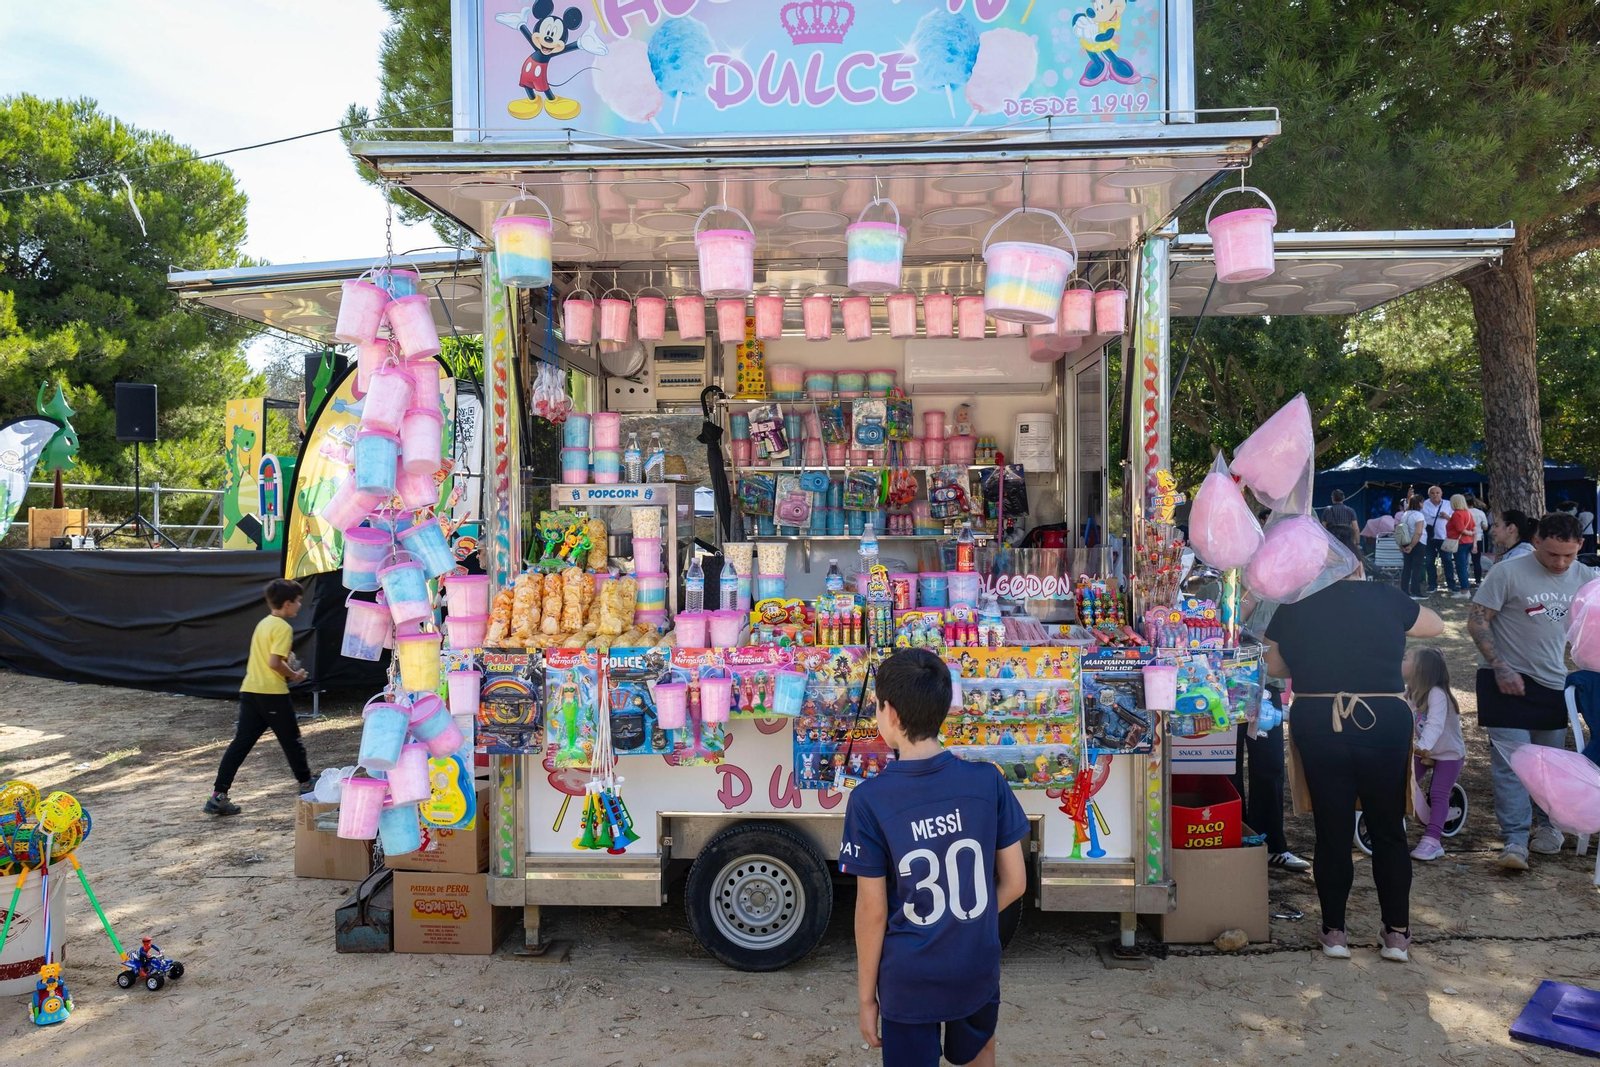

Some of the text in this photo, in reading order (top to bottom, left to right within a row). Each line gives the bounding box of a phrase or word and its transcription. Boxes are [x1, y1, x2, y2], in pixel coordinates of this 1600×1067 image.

[706, 52, 918, 110] DULCE
[1003, 93, 1149, 116] DESDE 1949
[588, 489, 639, 499] POPCORN
[483, 654, 529, 665] POLICE
[548, 657, 581, 666] Mermaids
[674, 655, 706, 665] Mermaids
[731, 656, 764, 665] Mermaids
[487, 664, 515, 672] GUN
[852, 728, 879, 740] GUYS
[1187, 821, 1225, 834] PACO
[898, 838, 988, 926] 30
[446, 884, 470, 893] PEROL
[414, 899, 467, 920] BONILLA
